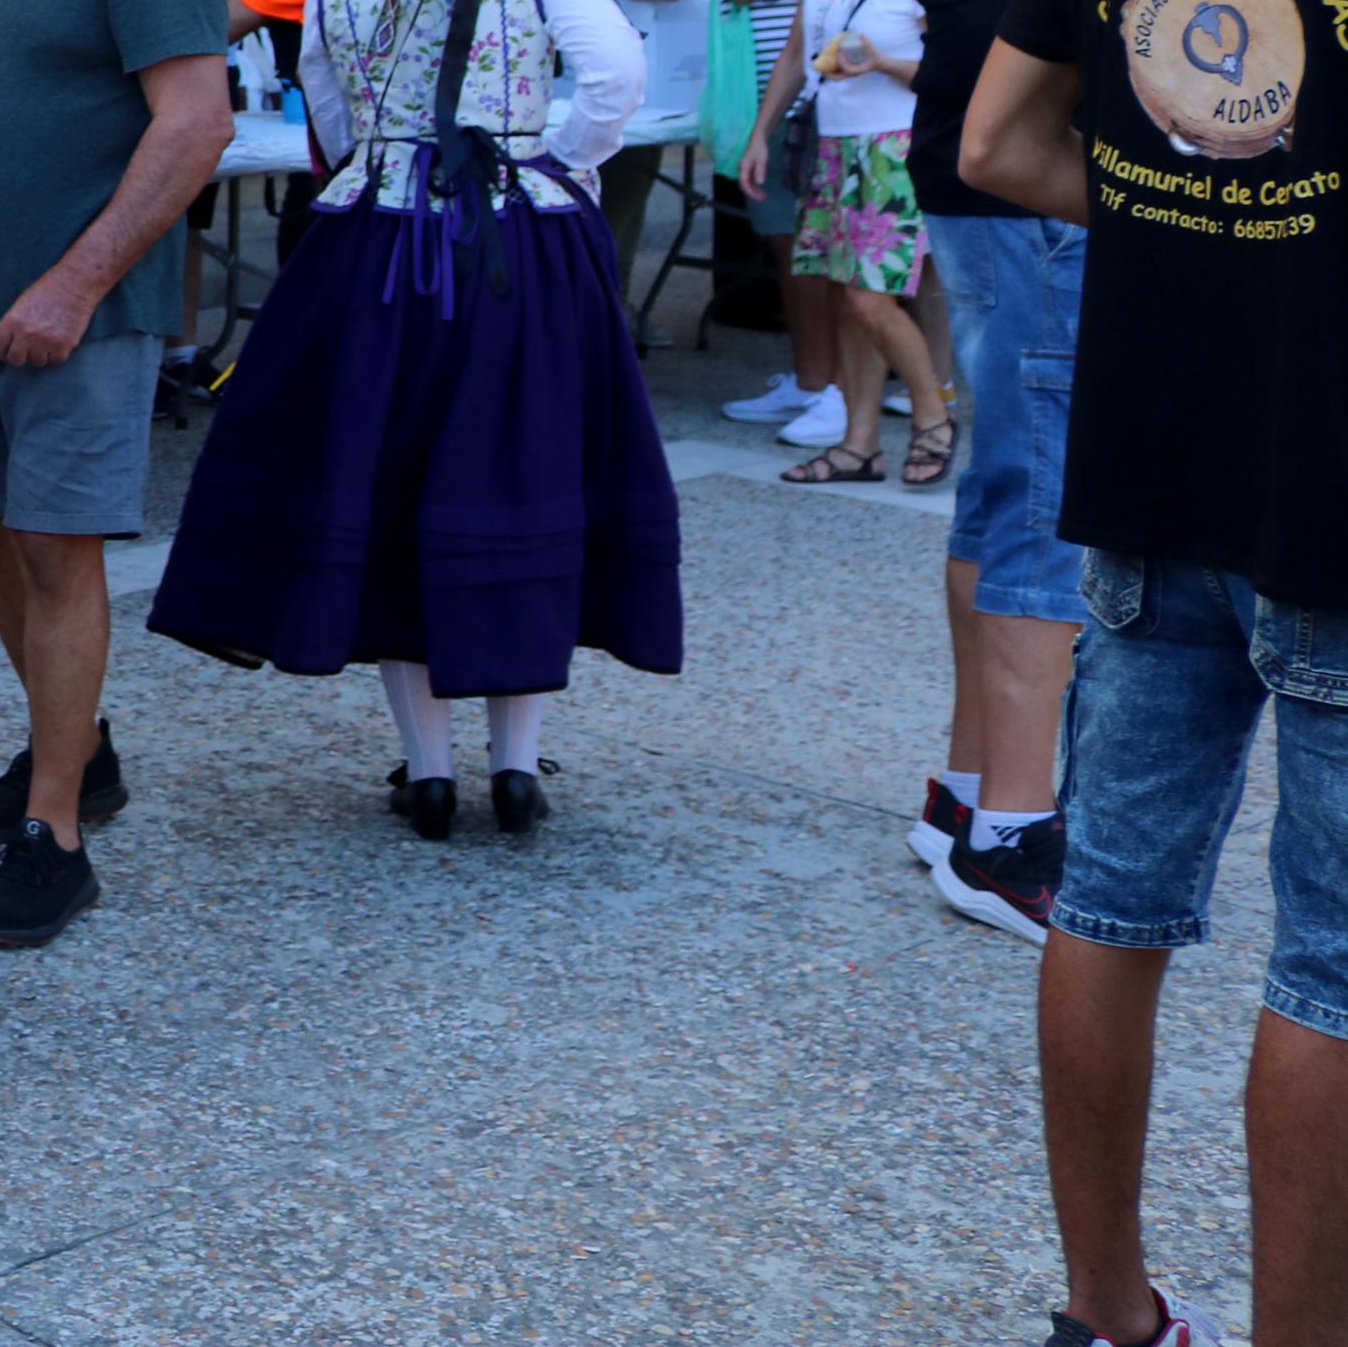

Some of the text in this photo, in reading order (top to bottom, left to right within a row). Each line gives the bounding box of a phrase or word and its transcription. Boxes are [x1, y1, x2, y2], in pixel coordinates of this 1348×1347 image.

[1213, 81, 1292, 124] ALDABA
[1092, 135, 1212, 200] Villamuriel
[1222, 179, 1253, 206] de
[1100, 183, 1127, 211] Tlf
[1131, 203, 1224, 234] contacto:
